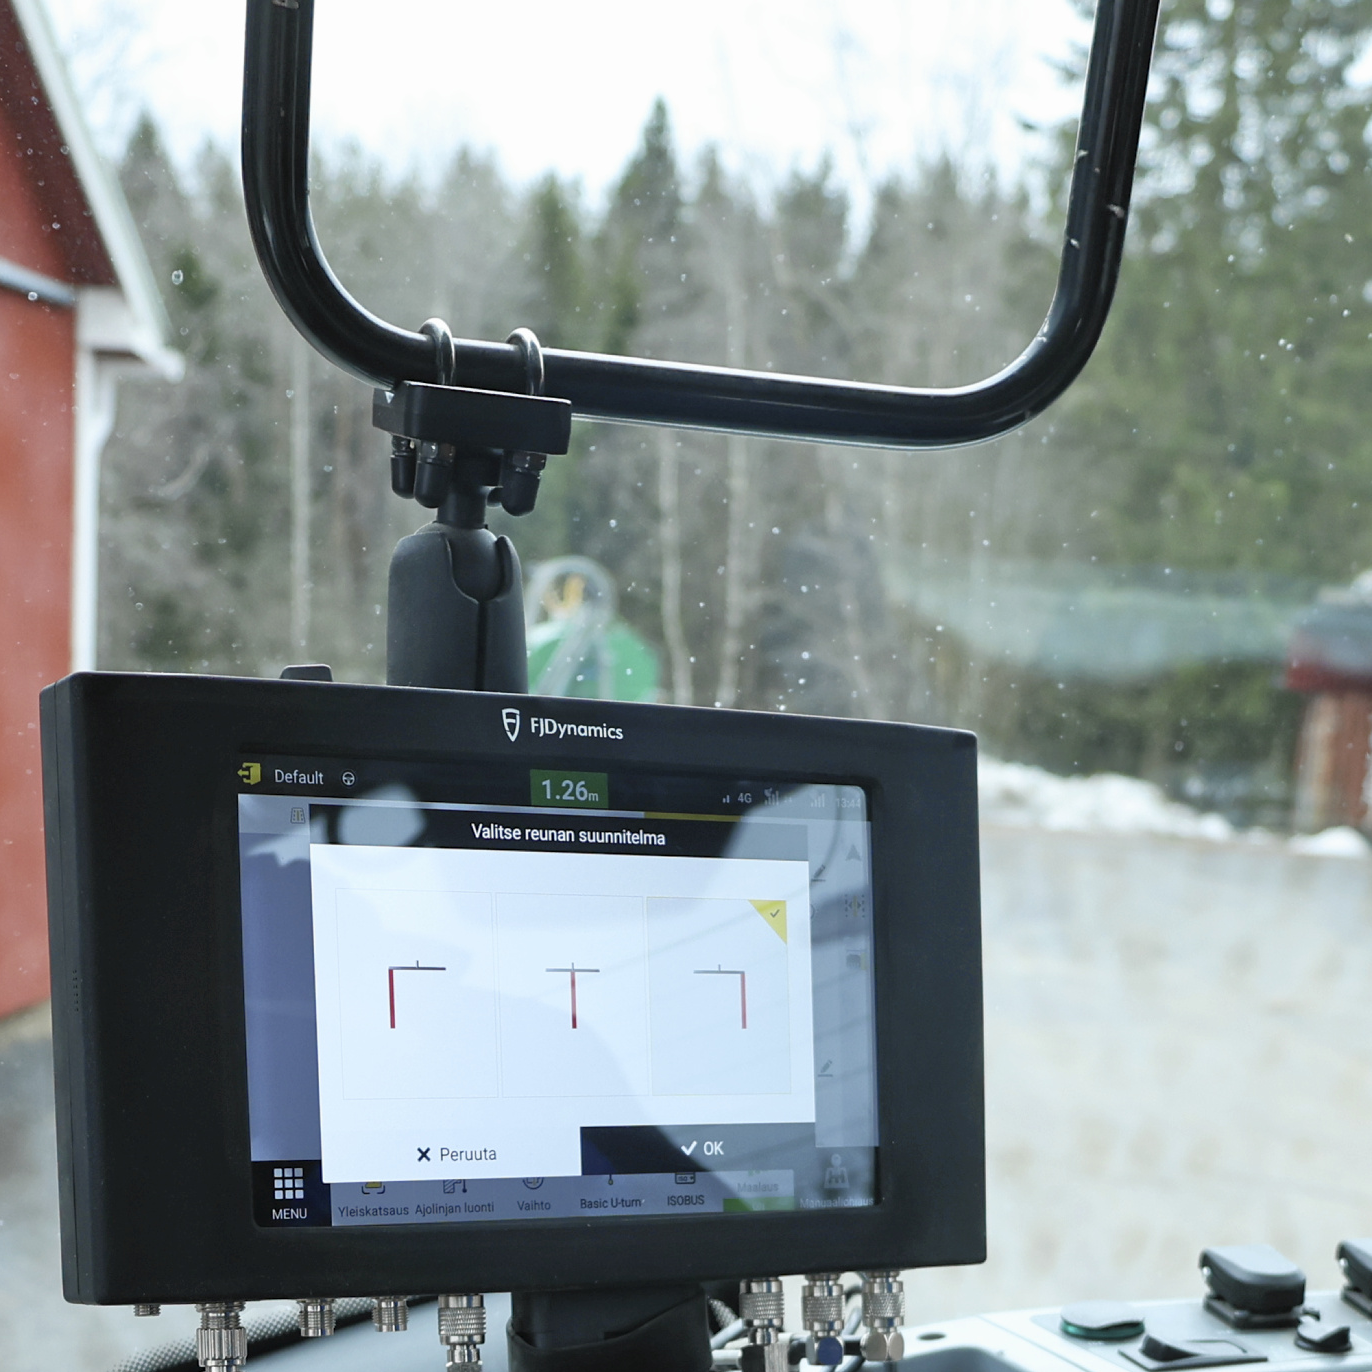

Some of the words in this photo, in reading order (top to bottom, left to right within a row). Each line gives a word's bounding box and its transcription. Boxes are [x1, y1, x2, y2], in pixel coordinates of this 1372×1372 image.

[530, 717, 624, 740] FJDynamics
[274, 769, 324, 785] Default
[737, 793, 752, 804] 4G
[471, 823, 522, 841] Valitse
[525, 827, 575, 842] reunan
[579, 829, 666, 845] suunnitelma
[439, 1146, 497, 1162] Peruuta
[703, 1141, 724, 1155] OK
[517, 1200, 551, 1212] Vaihto
[580, 1198, 609, 1210] Basic
[610, 1197, 642, 1209] U-turn
[667, 1195, 705, 1206] ISOBUS
[272, 1208, 308, 1220] MENU
[337, 1205, 409, 1218] Yleiskatsaus
[415, 1204, 462, 1216] Ajolinjan
[464, 1201, 495, 1213] luonti
